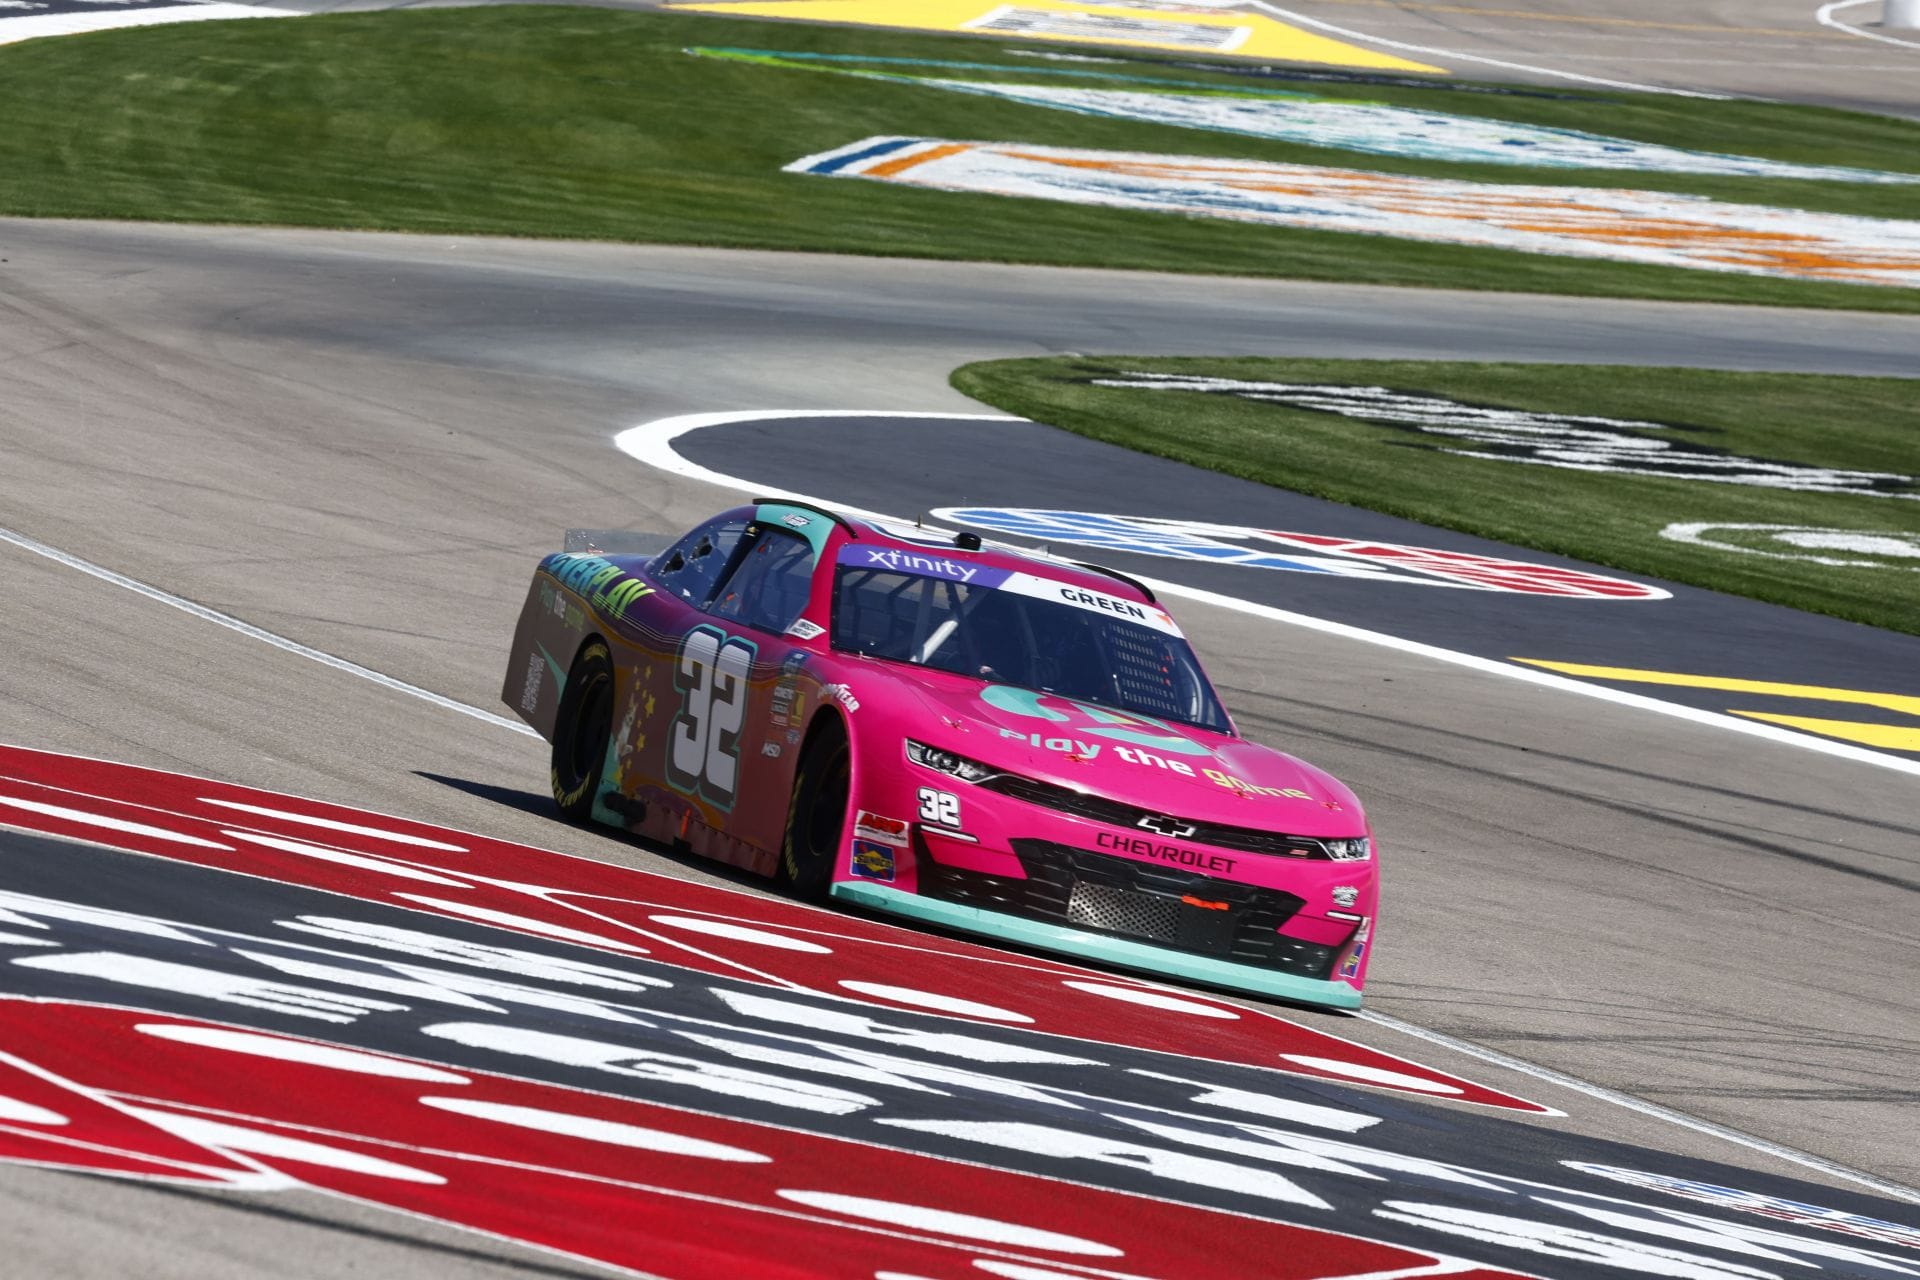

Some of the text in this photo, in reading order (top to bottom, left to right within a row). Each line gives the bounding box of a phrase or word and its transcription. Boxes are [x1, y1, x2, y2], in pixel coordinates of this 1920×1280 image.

[867, 550, 978, 582] xfinity
[1060, 587, 1146, 620] GREEN
[669, 627, 754, 800] 32
[761, 742, 781, 758] MSD
[1113, 745, 1197, 778] the
[1201, 768, 1314, 800] game
[917, 786, 961, 829] 32
[1096, 832, 1238, 874] CHEVROLET
